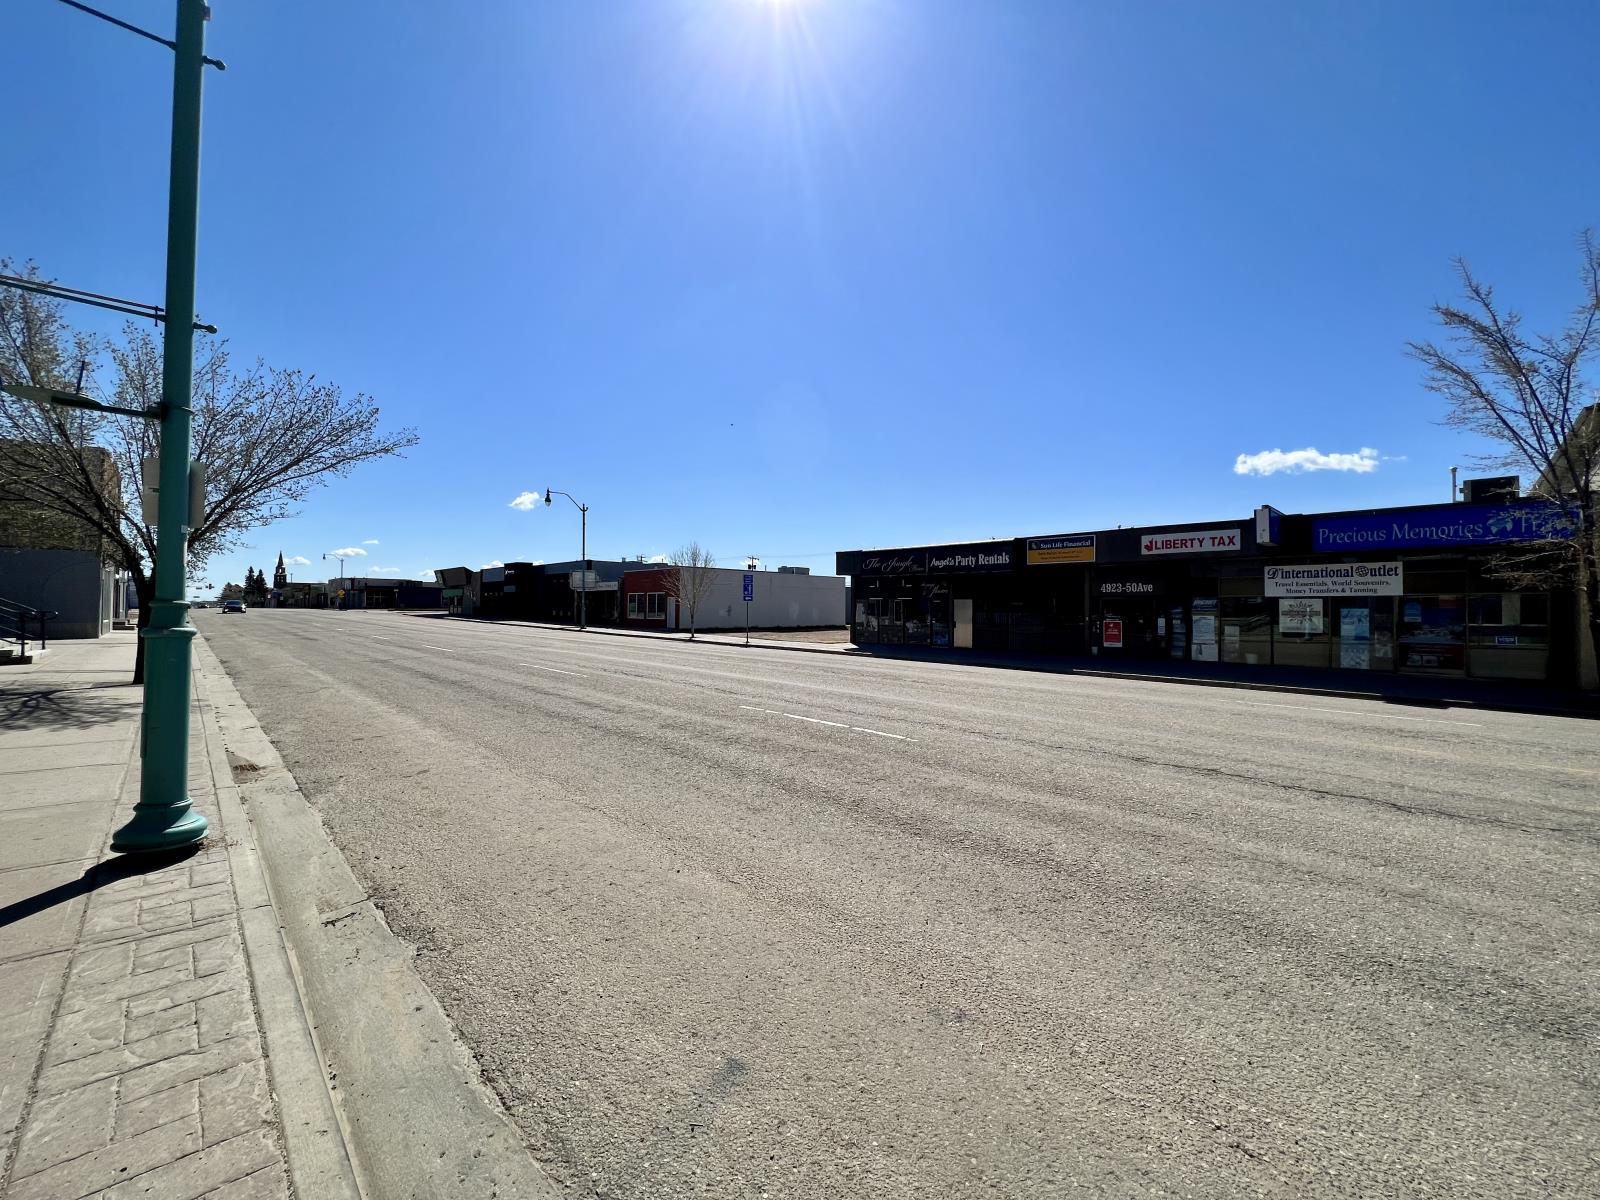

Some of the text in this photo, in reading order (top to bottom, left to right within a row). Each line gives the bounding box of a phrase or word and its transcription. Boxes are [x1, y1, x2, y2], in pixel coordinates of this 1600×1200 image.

[1319, 521, 1483, 544] Precious Memories
[1063, 539, 1091, 547] Financial
[1154, 535, 1236, 551] LIBERTY TAX
[863, 558, 881, 570] The
[955, 556, 976, 567] Party
[978, 552, 1010, 565] Rentals
